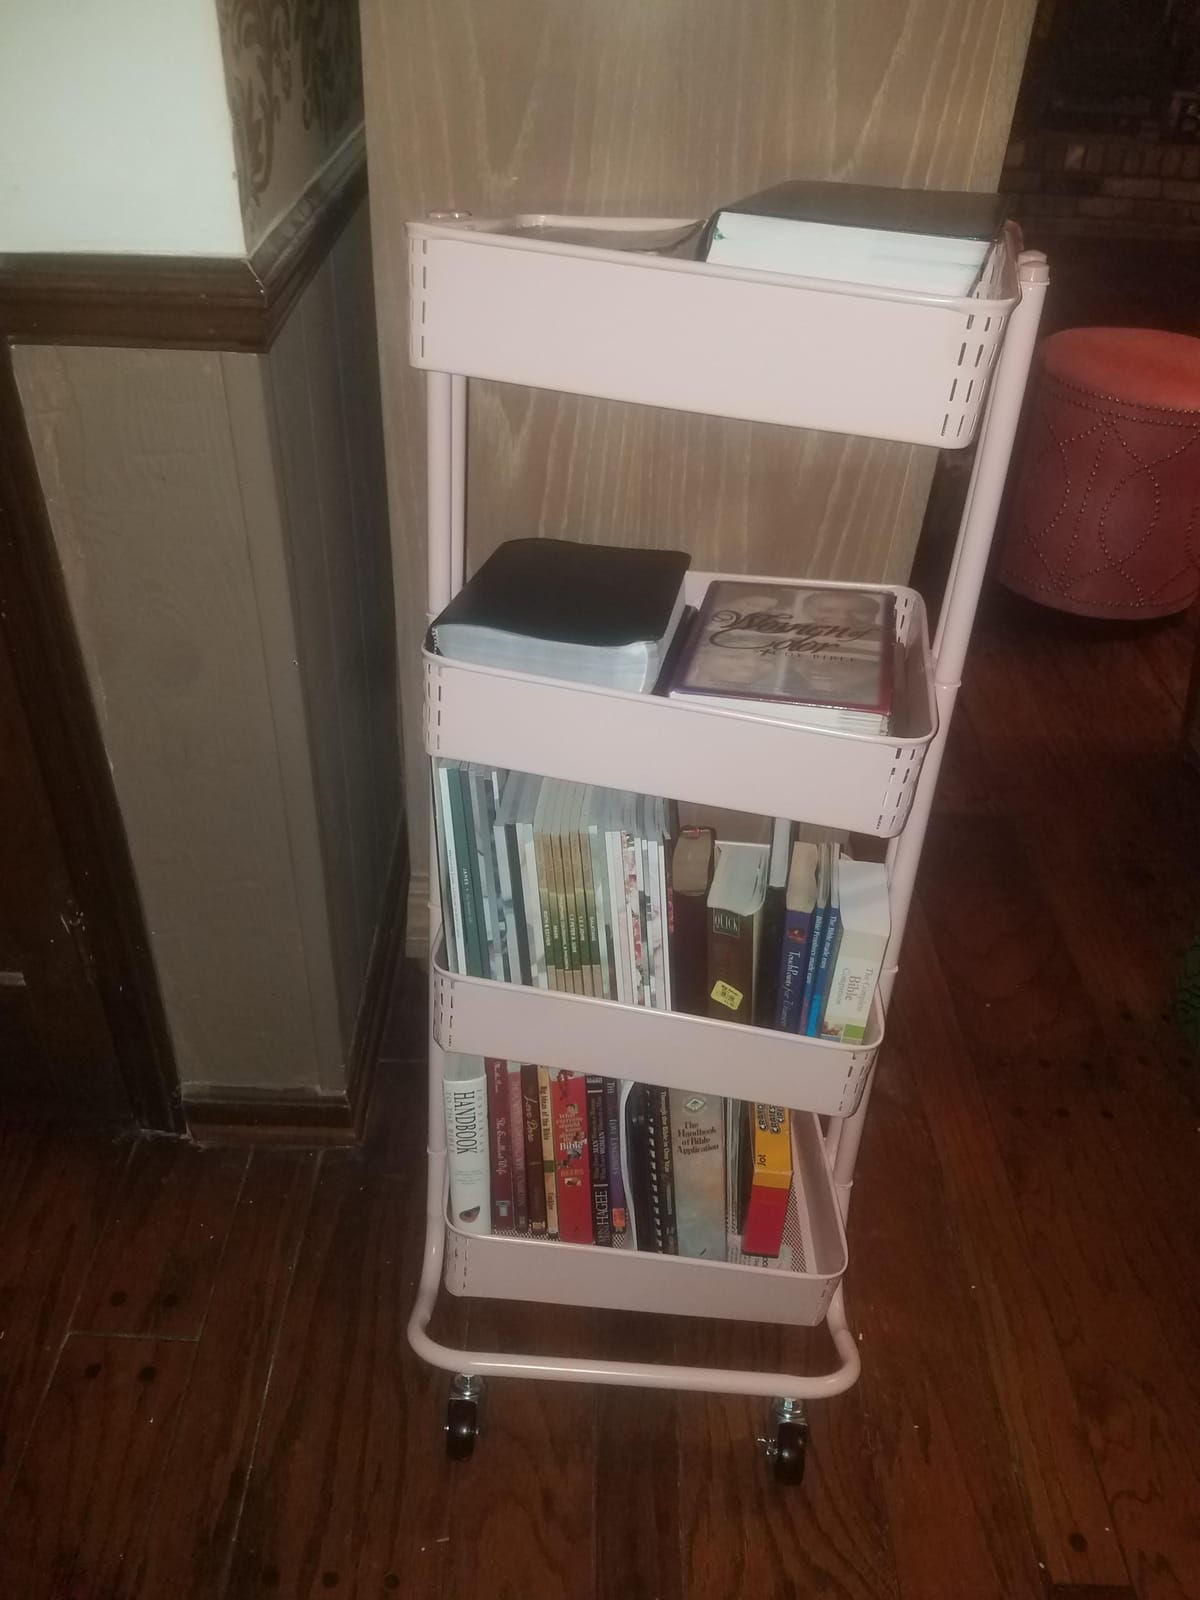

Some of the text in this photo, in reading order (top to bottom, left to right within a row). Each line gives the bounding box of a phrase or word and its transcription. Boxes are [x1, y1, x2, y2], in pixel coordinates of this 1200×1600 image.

[709, 627, 840, 653] Color
[845, 976, 861, 1001] Bible
[453, 1091, 477, 1155] HANDBOOK
[684, 1121, 699, 1129] The
[757, 1104, 767, 1131] CRAYO
[678, 1126, 716, 1137] Handbook
[560, 1140, 583, 1151] Bible
[677, 1144, 719, 1155] Application
[691, 1137, 711, 1145] Bible
[594, 1191, 609, 1225] HAGEE
